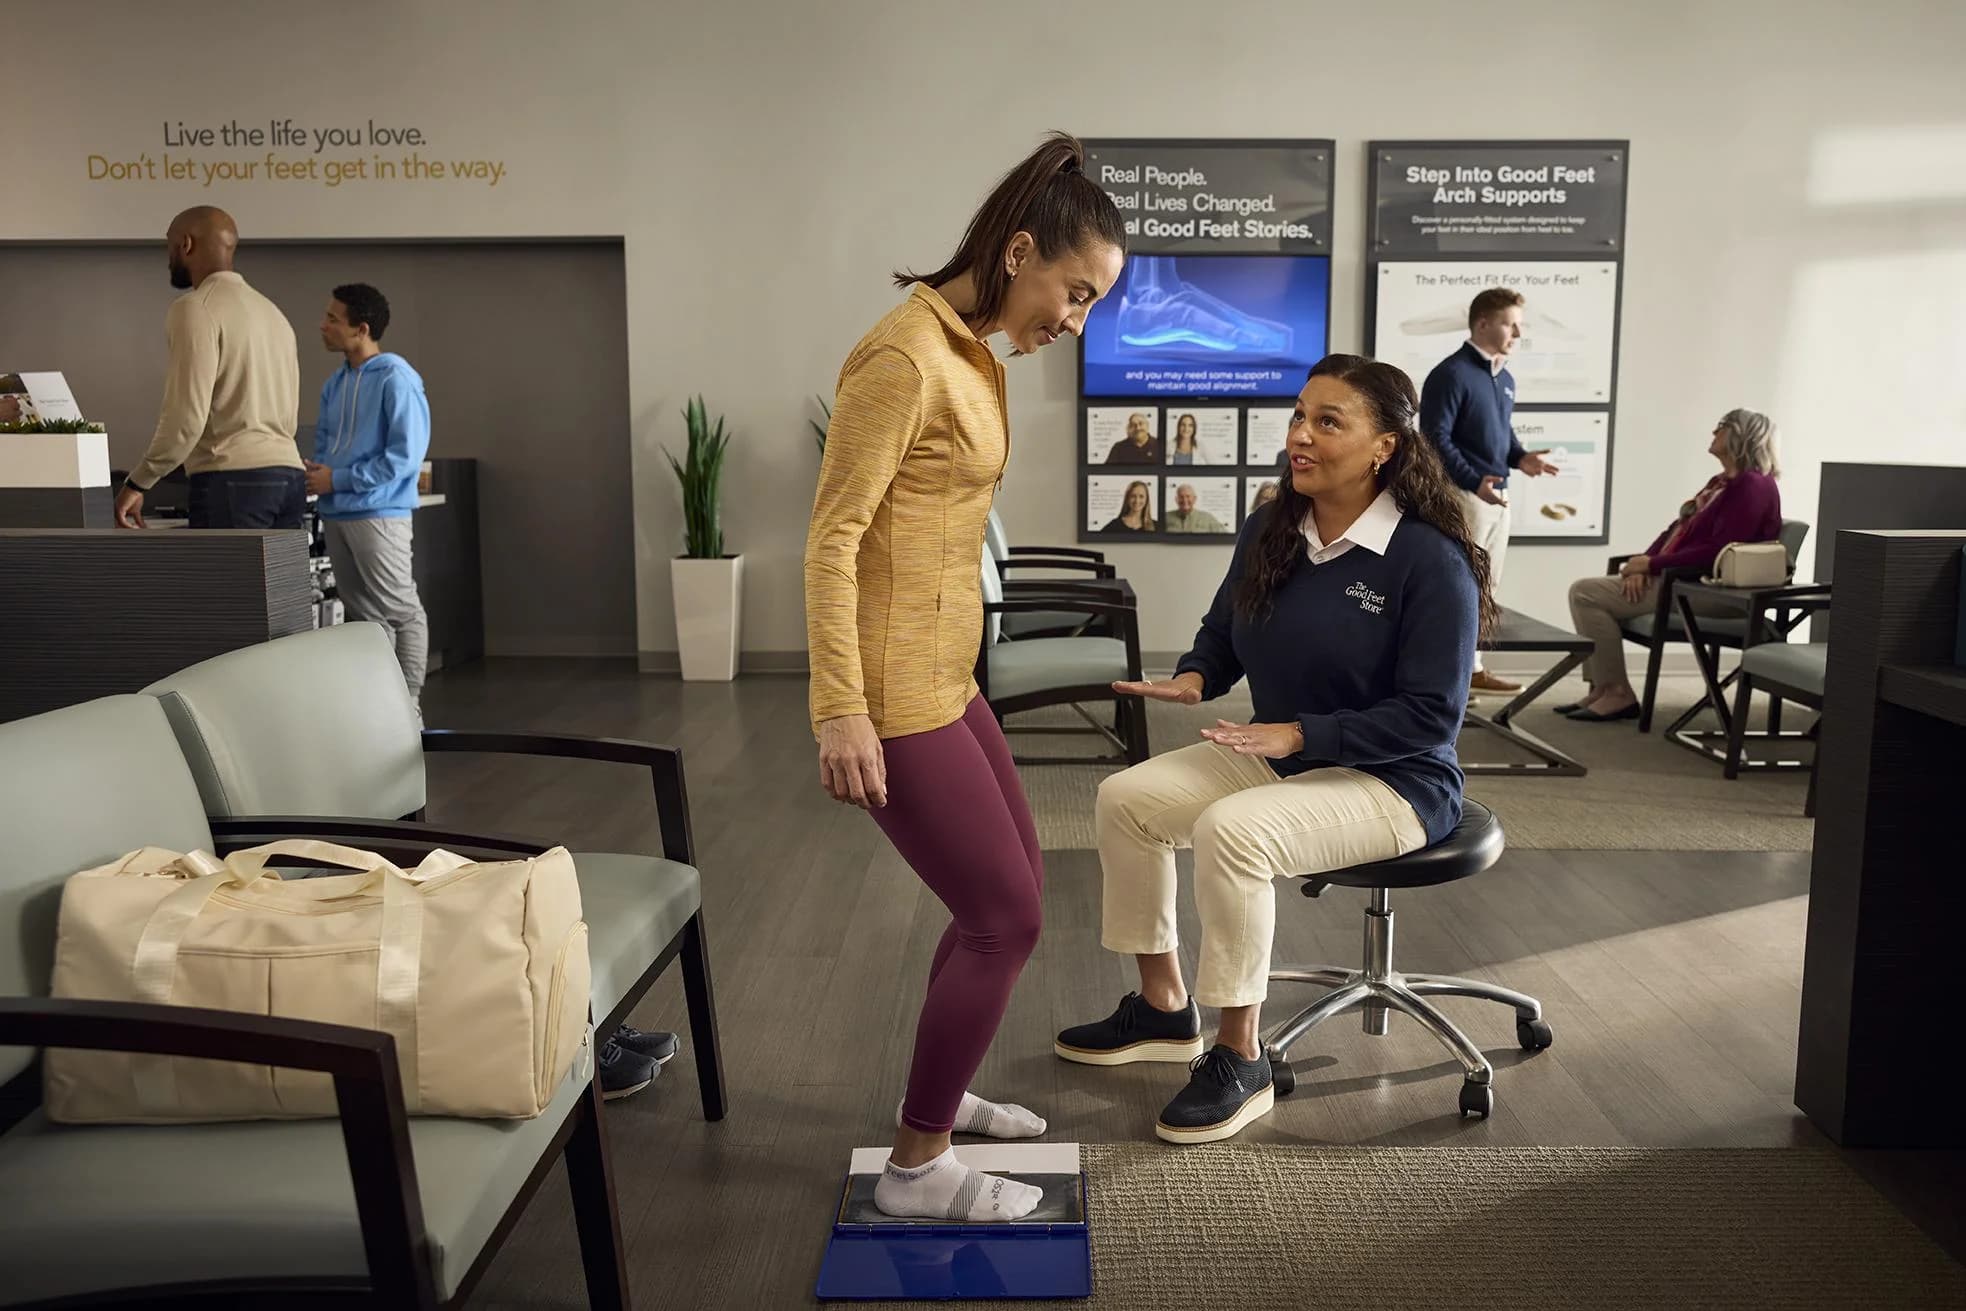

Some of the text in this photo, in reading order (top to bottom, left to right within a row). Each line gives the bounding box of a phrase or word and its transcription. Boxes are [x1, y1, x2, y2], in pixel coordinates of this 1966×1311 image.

[163, 119, 427, 154] Live the life you love.
[87, 152, 507, 188] Don't let your feet get in the way.
[1101, 165, 1208, 190] Real People.
[1406, 166, 1596, 186] Step Into Good Feet
[1145, 193, 1188, 211] Lives
[1193, 193, 1276, 216] Changed.
[1433, 187, 1567, 207] Arch Supports
[1125, 218, 1313, 238] al Good Feet Stories.
[1416, 274, 1579, 286] The Perfect Fit For Your Feet
[1125, 371, 1143, 380] and
[1144, 373, 1162, 381] you
[1163, 373, 1182, 381] may
[1185, 371, 1208, 380] need
[1235, 371, 1270, 381] support
[1271, 371, 1282, 380] to
[1148, 382, 1259, 392] maintain good alignment.
[1514, 424, 1544, 434] stem
[1345, 585, 1385, 605] Good Feet
[1355, 581, 1367, 591] The
[1359, 599, 1383, 615] Store
